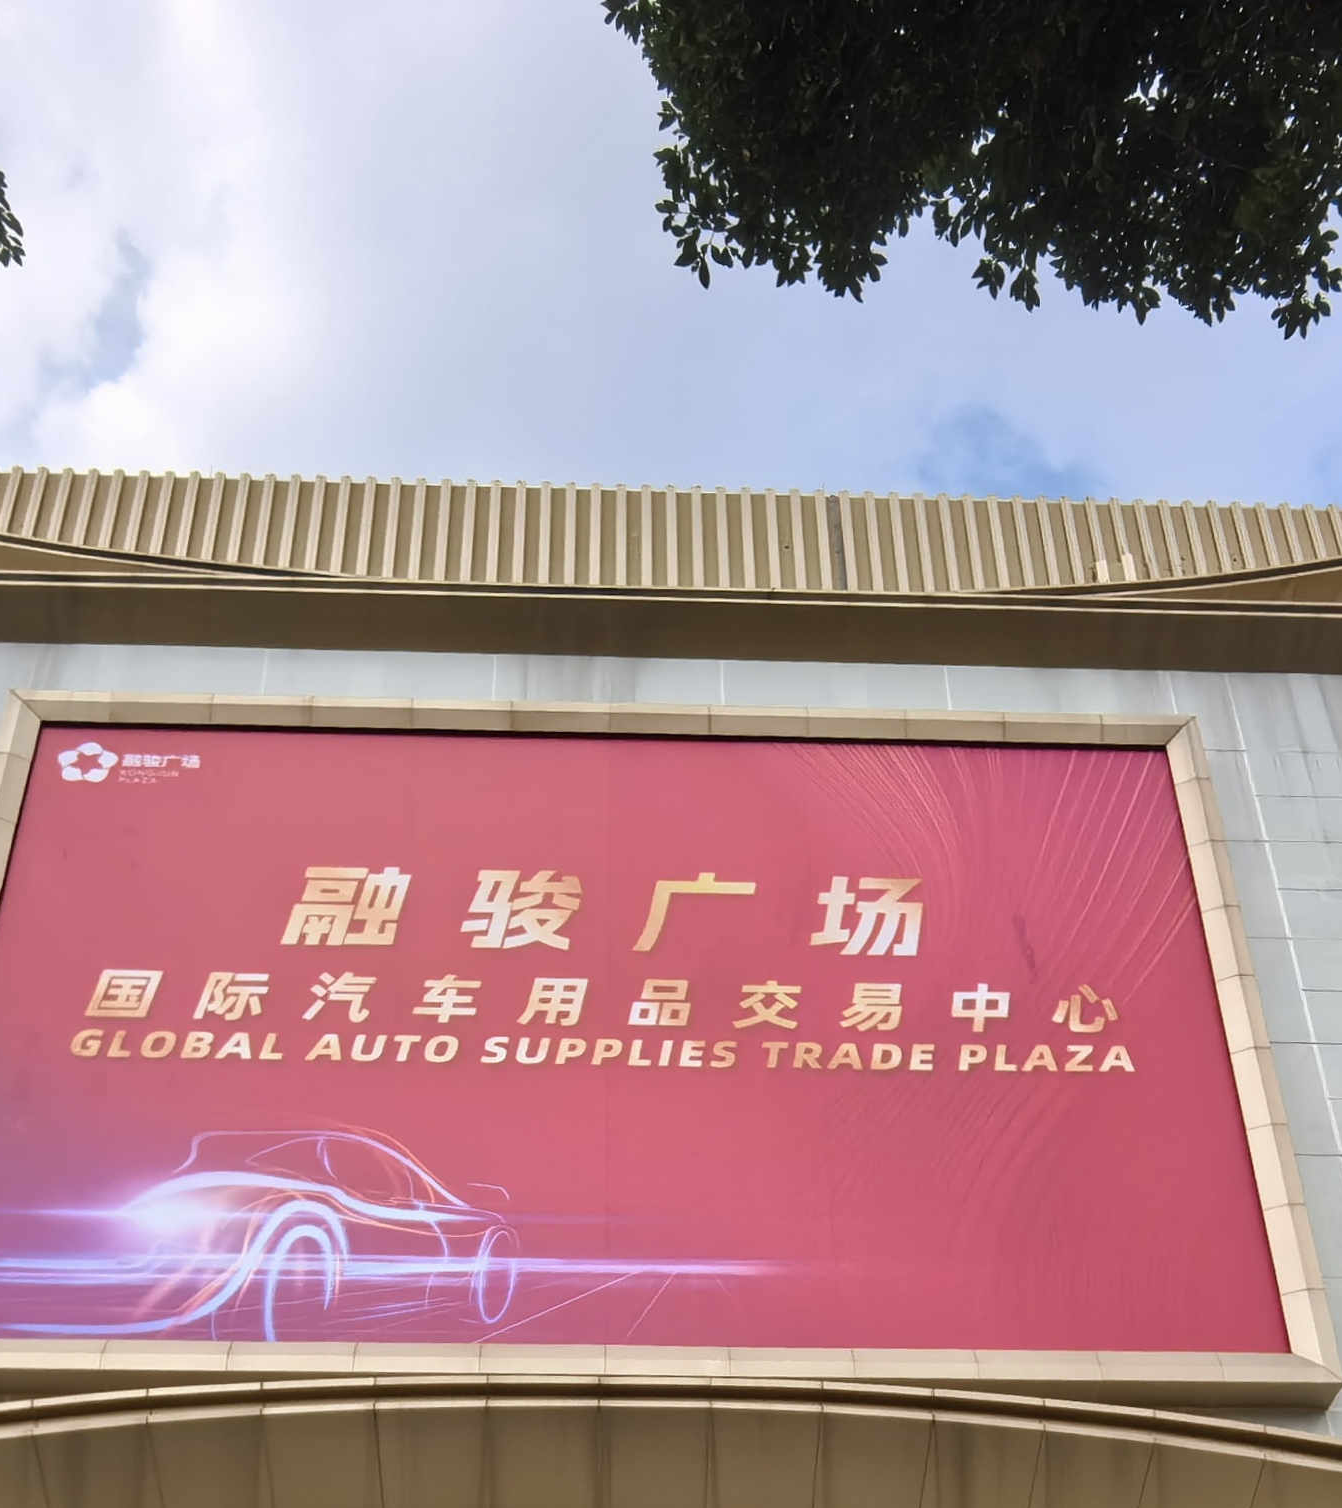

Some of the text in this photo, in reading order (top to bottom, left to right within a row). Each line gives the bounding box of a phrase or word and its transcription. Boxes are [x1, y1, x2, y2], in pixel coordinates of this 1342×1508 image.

[280, 866, 923, 956] 融骏广场
[84, 968, 1119, 1033] 国际汽车用品交易中心
[70, 1028, 1136, 1073] GLOBAL AUTO SUPPLIES TRADE PLAZA
